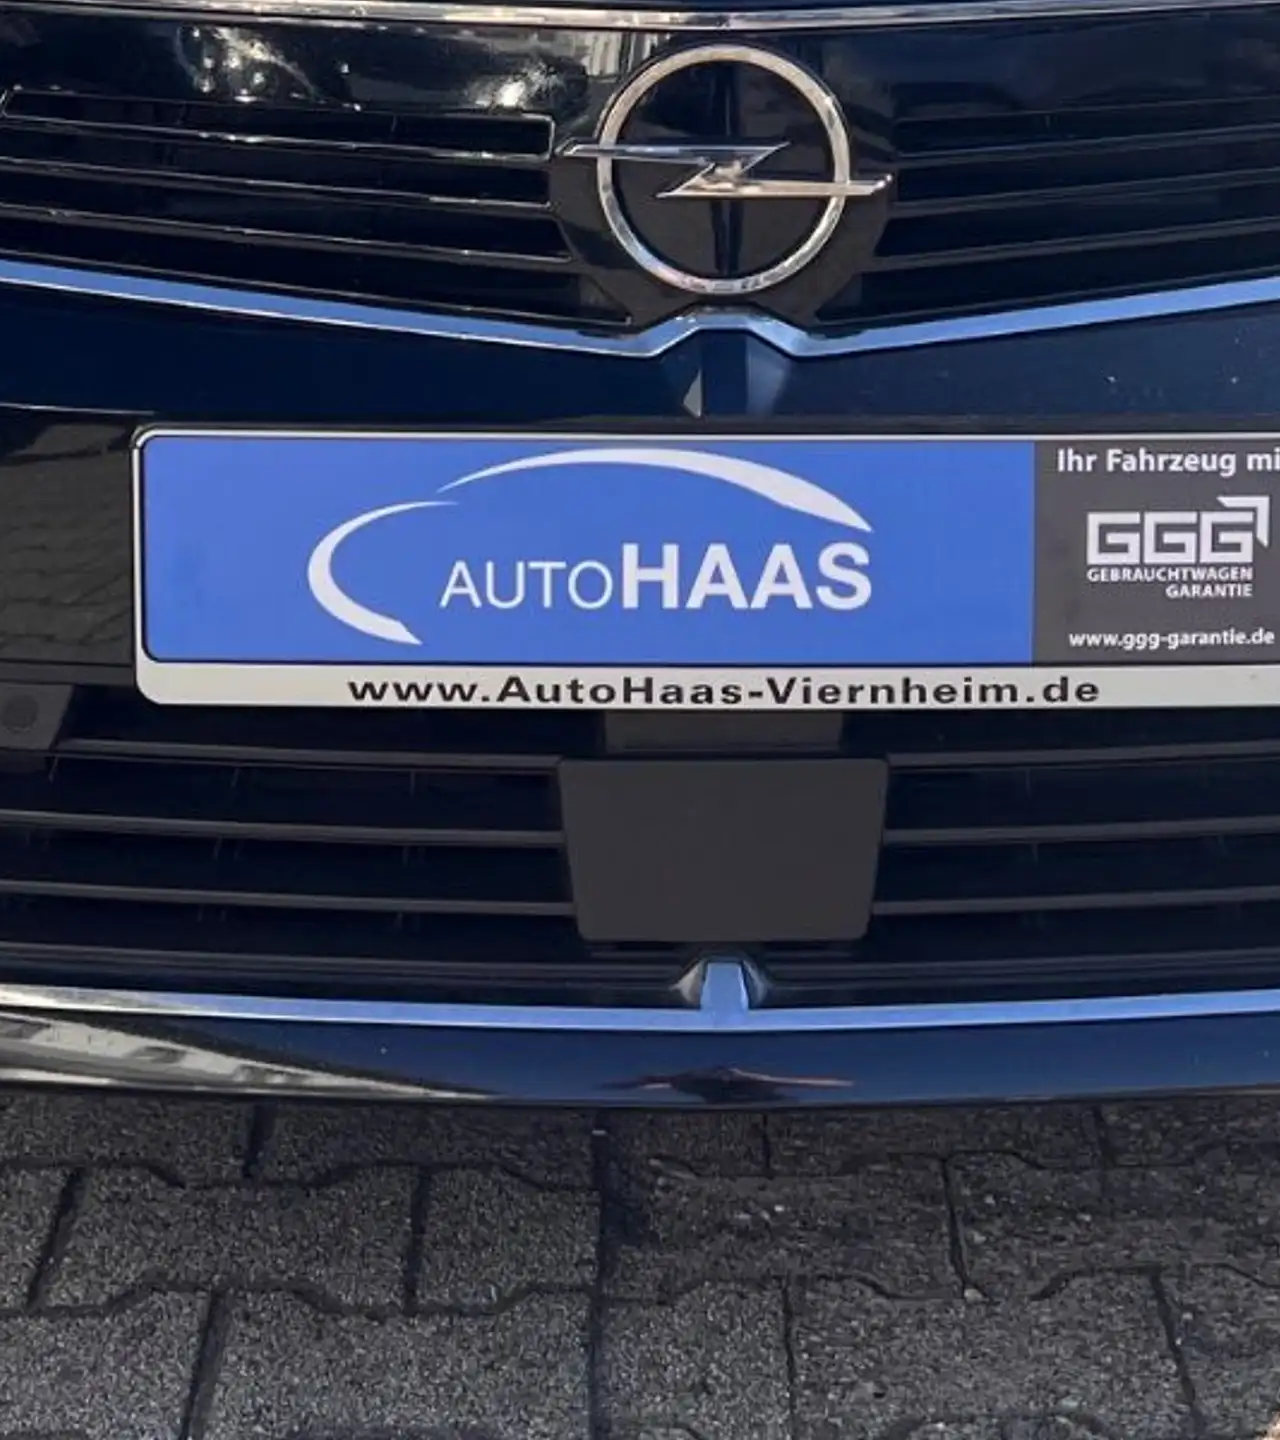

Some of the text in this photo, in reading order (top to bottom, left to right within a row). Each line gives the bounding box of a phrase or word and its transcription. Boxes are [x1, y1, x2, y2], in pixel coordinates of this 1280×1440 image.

[1057, 448, 1098, 472] Ihr
[1106, 448, 1237, 478] Fahrzeug
[1086, 511, 1254, 565] GGG
[1086, 566, 1254, 582] GEBRAUCHTWAGEN
[1165, 583, 1254, 599] GARANTIE
[1069, 627, 1276, 651] www.ggg-garantie.de
[347, 675, 1100, 705] www.AutoHaas-Viernheim.de
